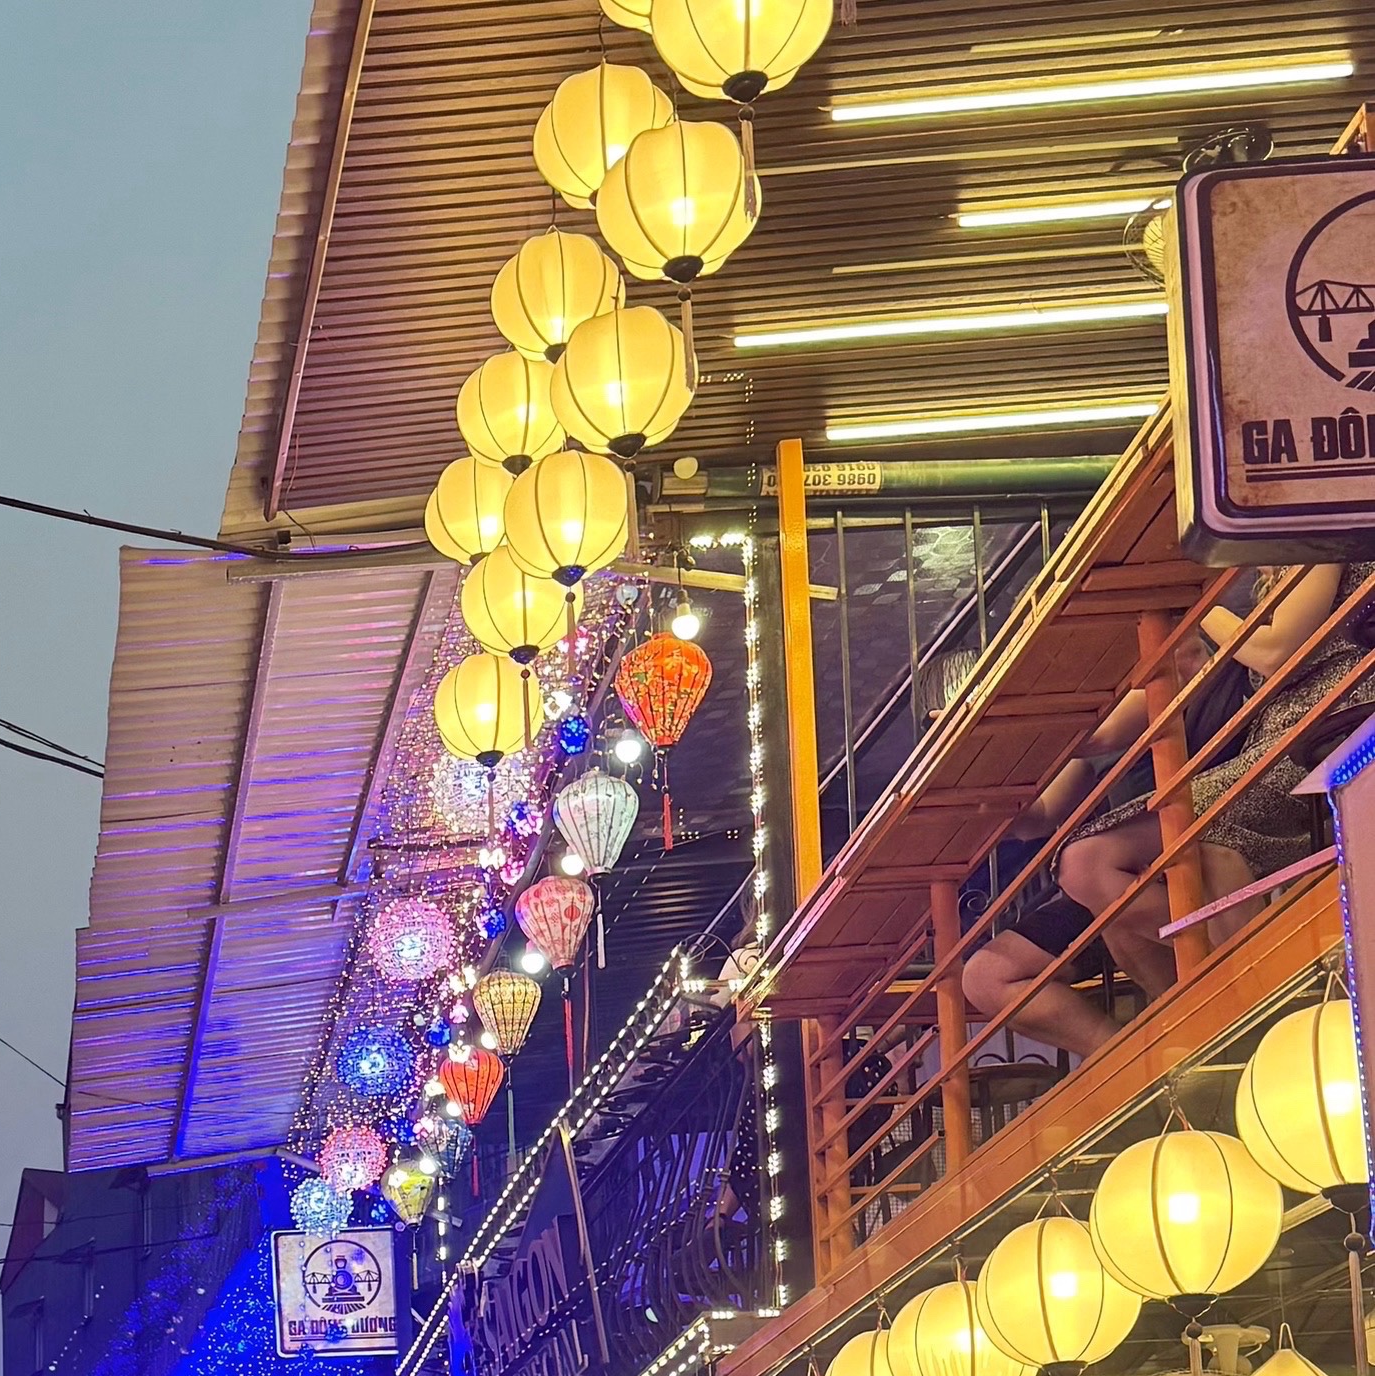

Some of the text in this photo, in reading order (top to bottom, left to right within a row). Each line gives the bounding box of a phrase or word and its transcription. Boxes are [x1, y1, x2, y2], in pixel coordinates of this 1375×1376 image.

[1242, 420, 1298, 465] GA
[837, 472, 876, 486] 0986
[482, 1217, 569, 1374] SAIGON
[288, 1319, 307, 1337] GA
